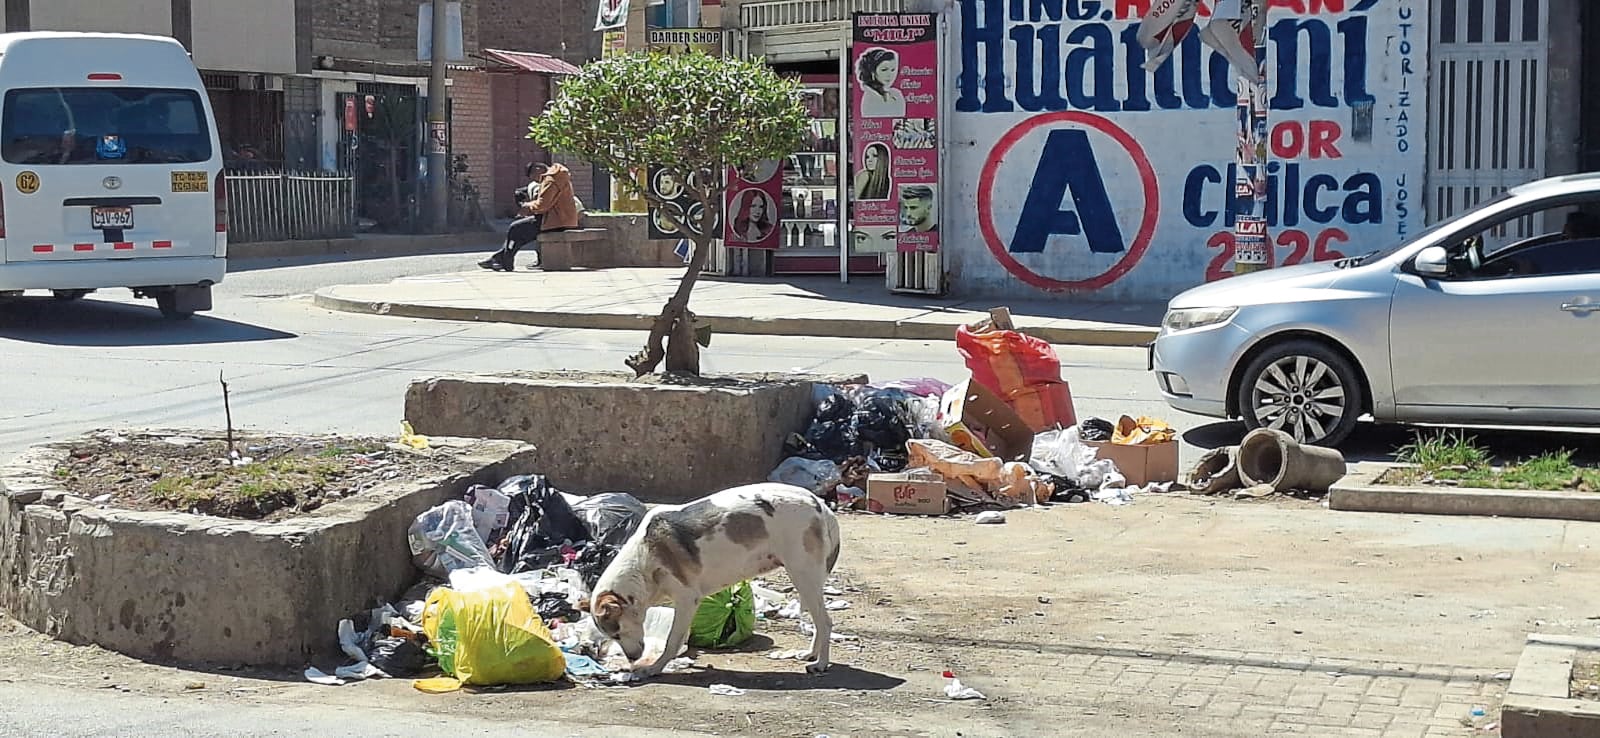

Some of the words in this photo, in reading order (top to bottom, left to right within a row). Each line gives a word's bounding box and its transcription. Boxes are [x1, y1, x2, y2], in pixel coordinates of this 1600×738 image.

[652, 31, 691, 43] BARBER
[692, 31, 719, 43] SHOP
[1270, 120, 1342, 159] OR
[21, 174, 35, 189] 62
[1008, 129, 1125, 253] A
